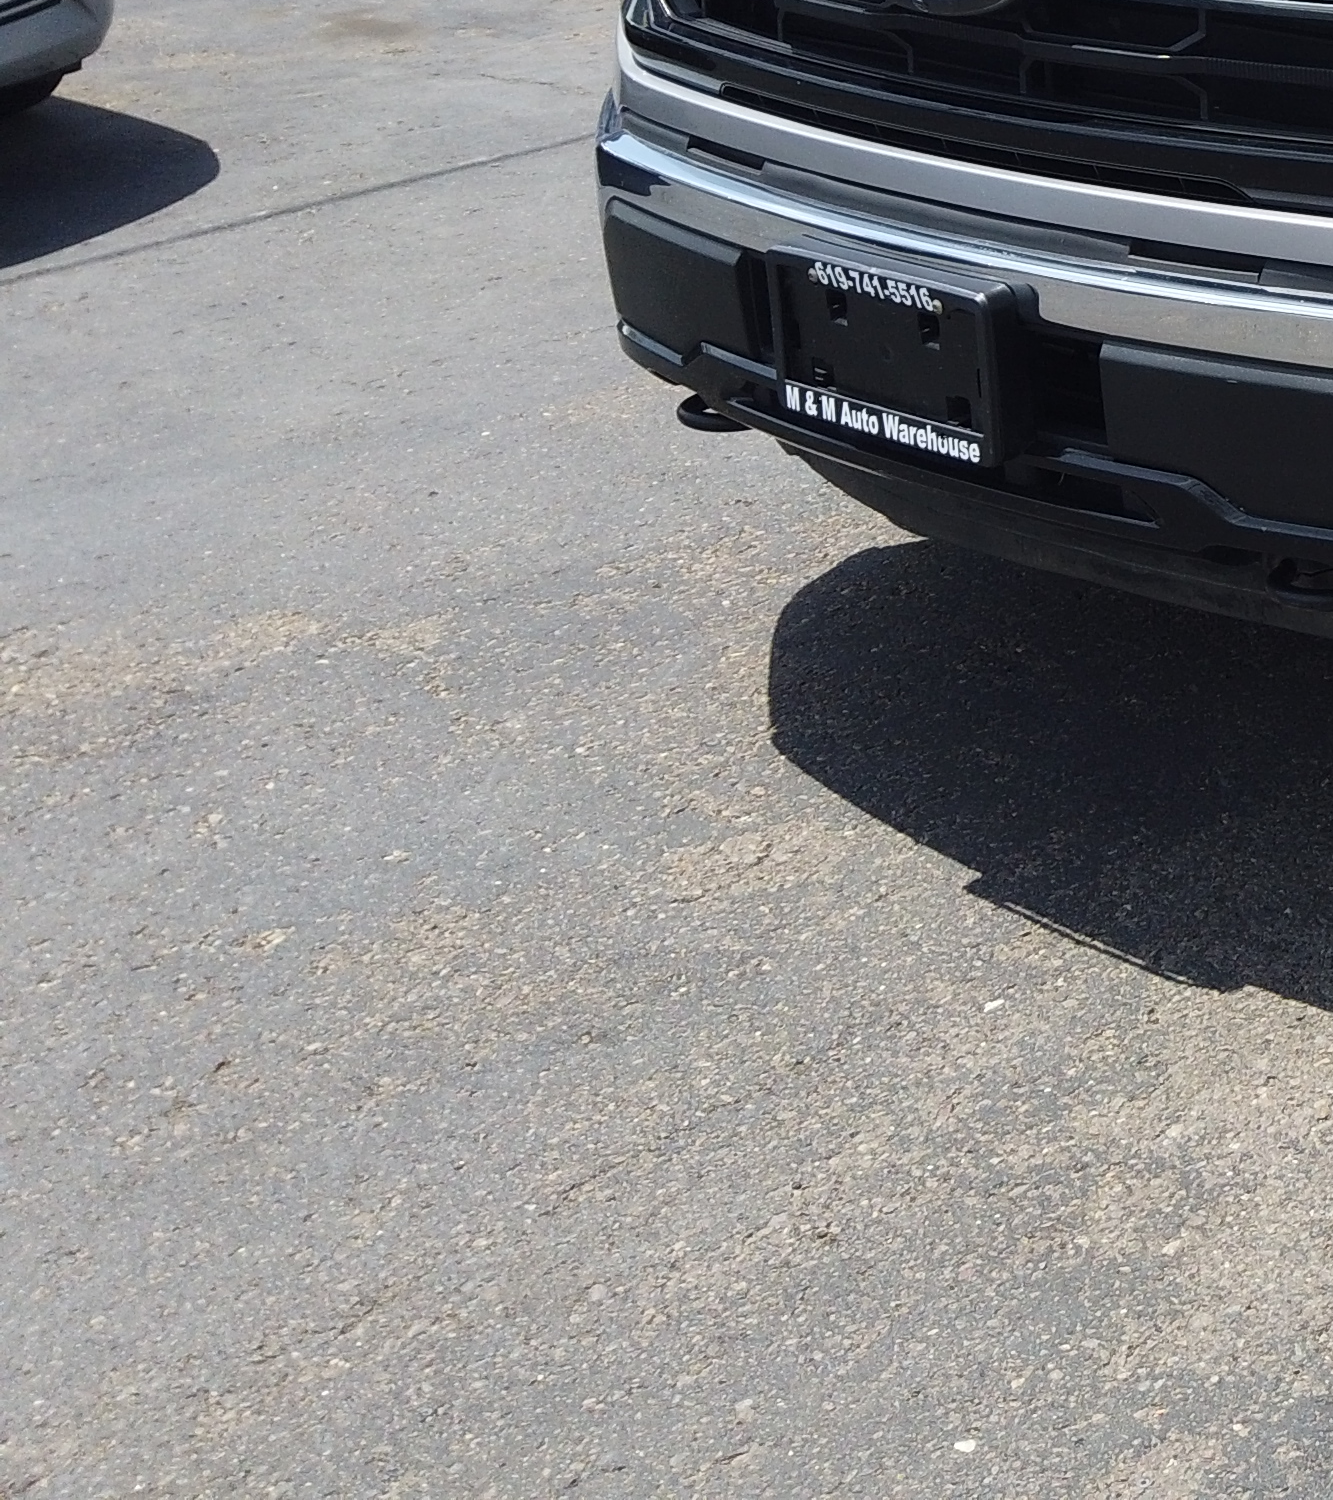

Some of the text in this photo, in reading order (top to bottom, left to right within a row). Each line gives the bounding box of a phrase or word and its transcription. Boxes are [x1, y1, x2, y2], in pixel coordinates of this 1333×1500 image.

[814, 261, 935, 312] 619-741-5516
[785, 384, 982, 463] M & M Auto Warehouse
